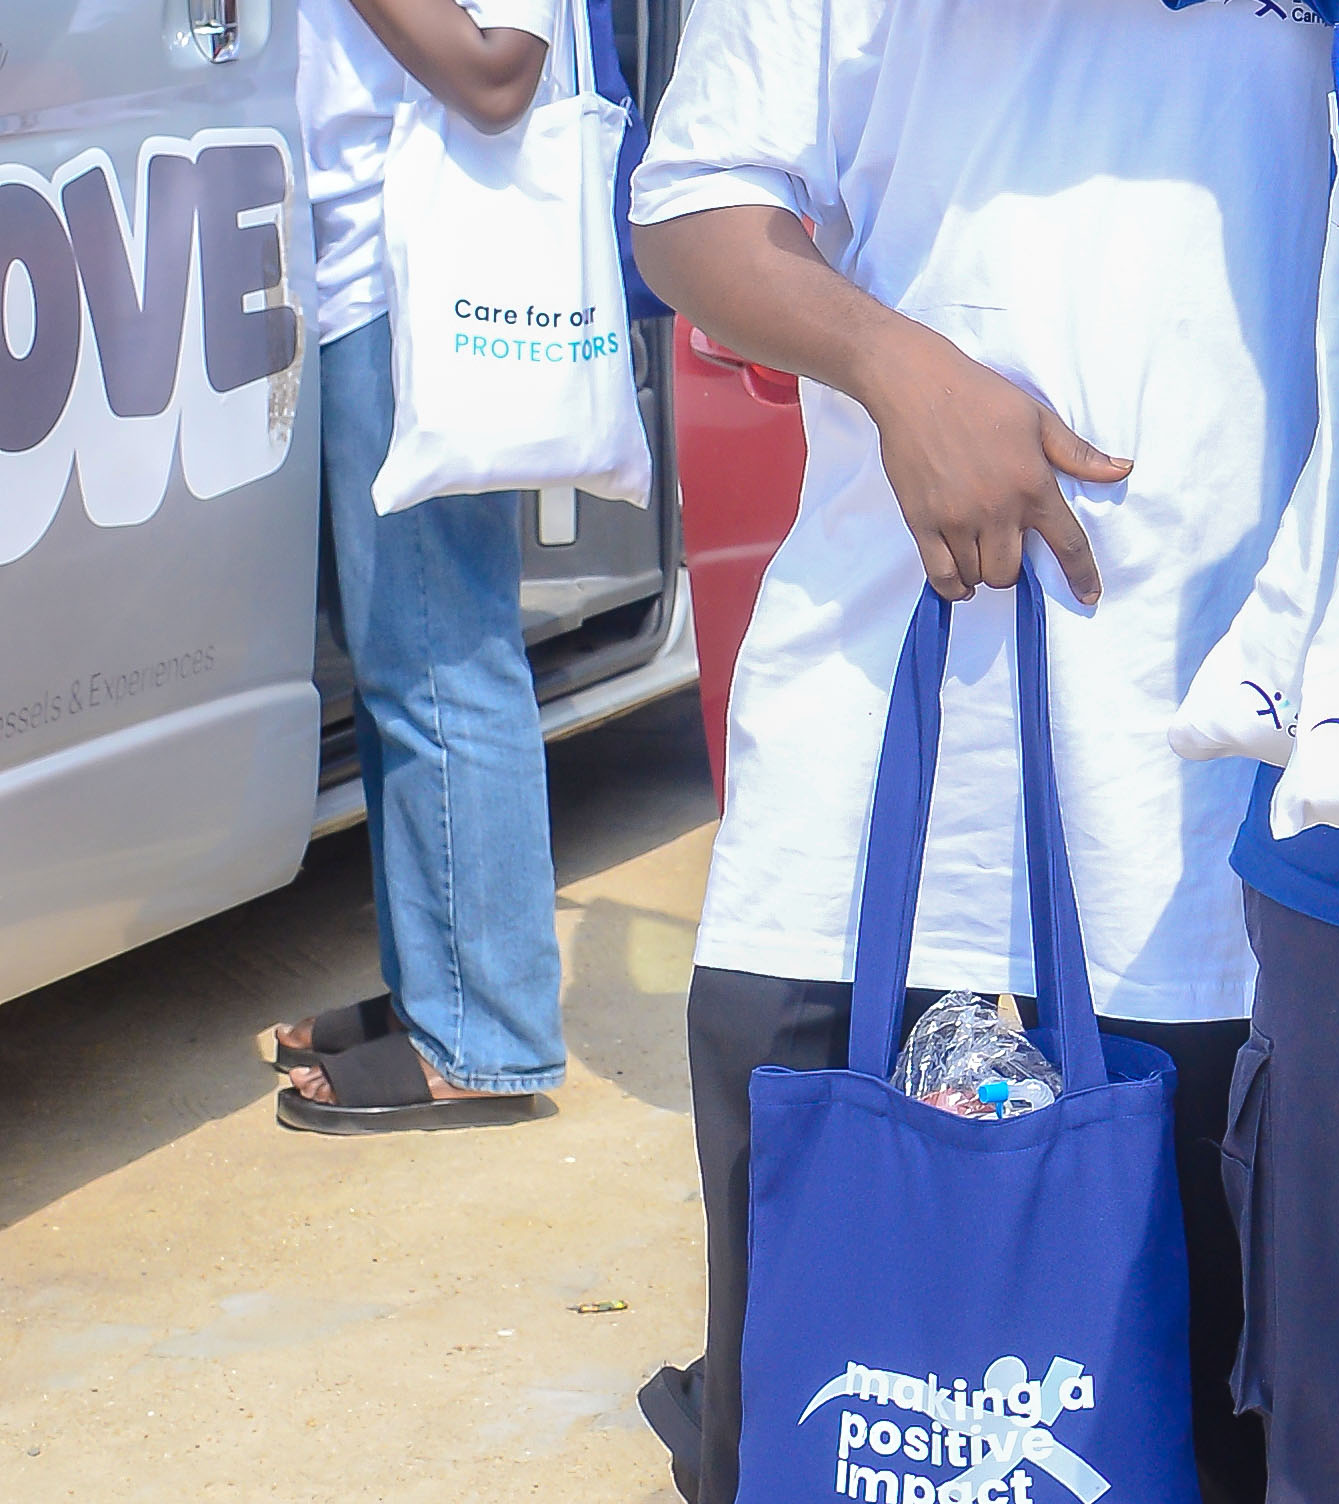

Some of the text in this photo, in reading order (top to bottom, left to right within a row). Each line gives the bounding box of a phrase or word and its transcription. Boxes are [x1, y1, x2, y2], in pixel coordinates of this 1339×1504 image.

[454, 299, 518, 325] Care
[526, 305, 562, 328] for
[454, 332, 619, 363] PROTECTORS
[0, 691, 63, 739] ssels
[89, 644, 215, 707] Experiences
[846, 1360, 1096, 1427] making a
[838, 1410, 1055, 1469] positive
